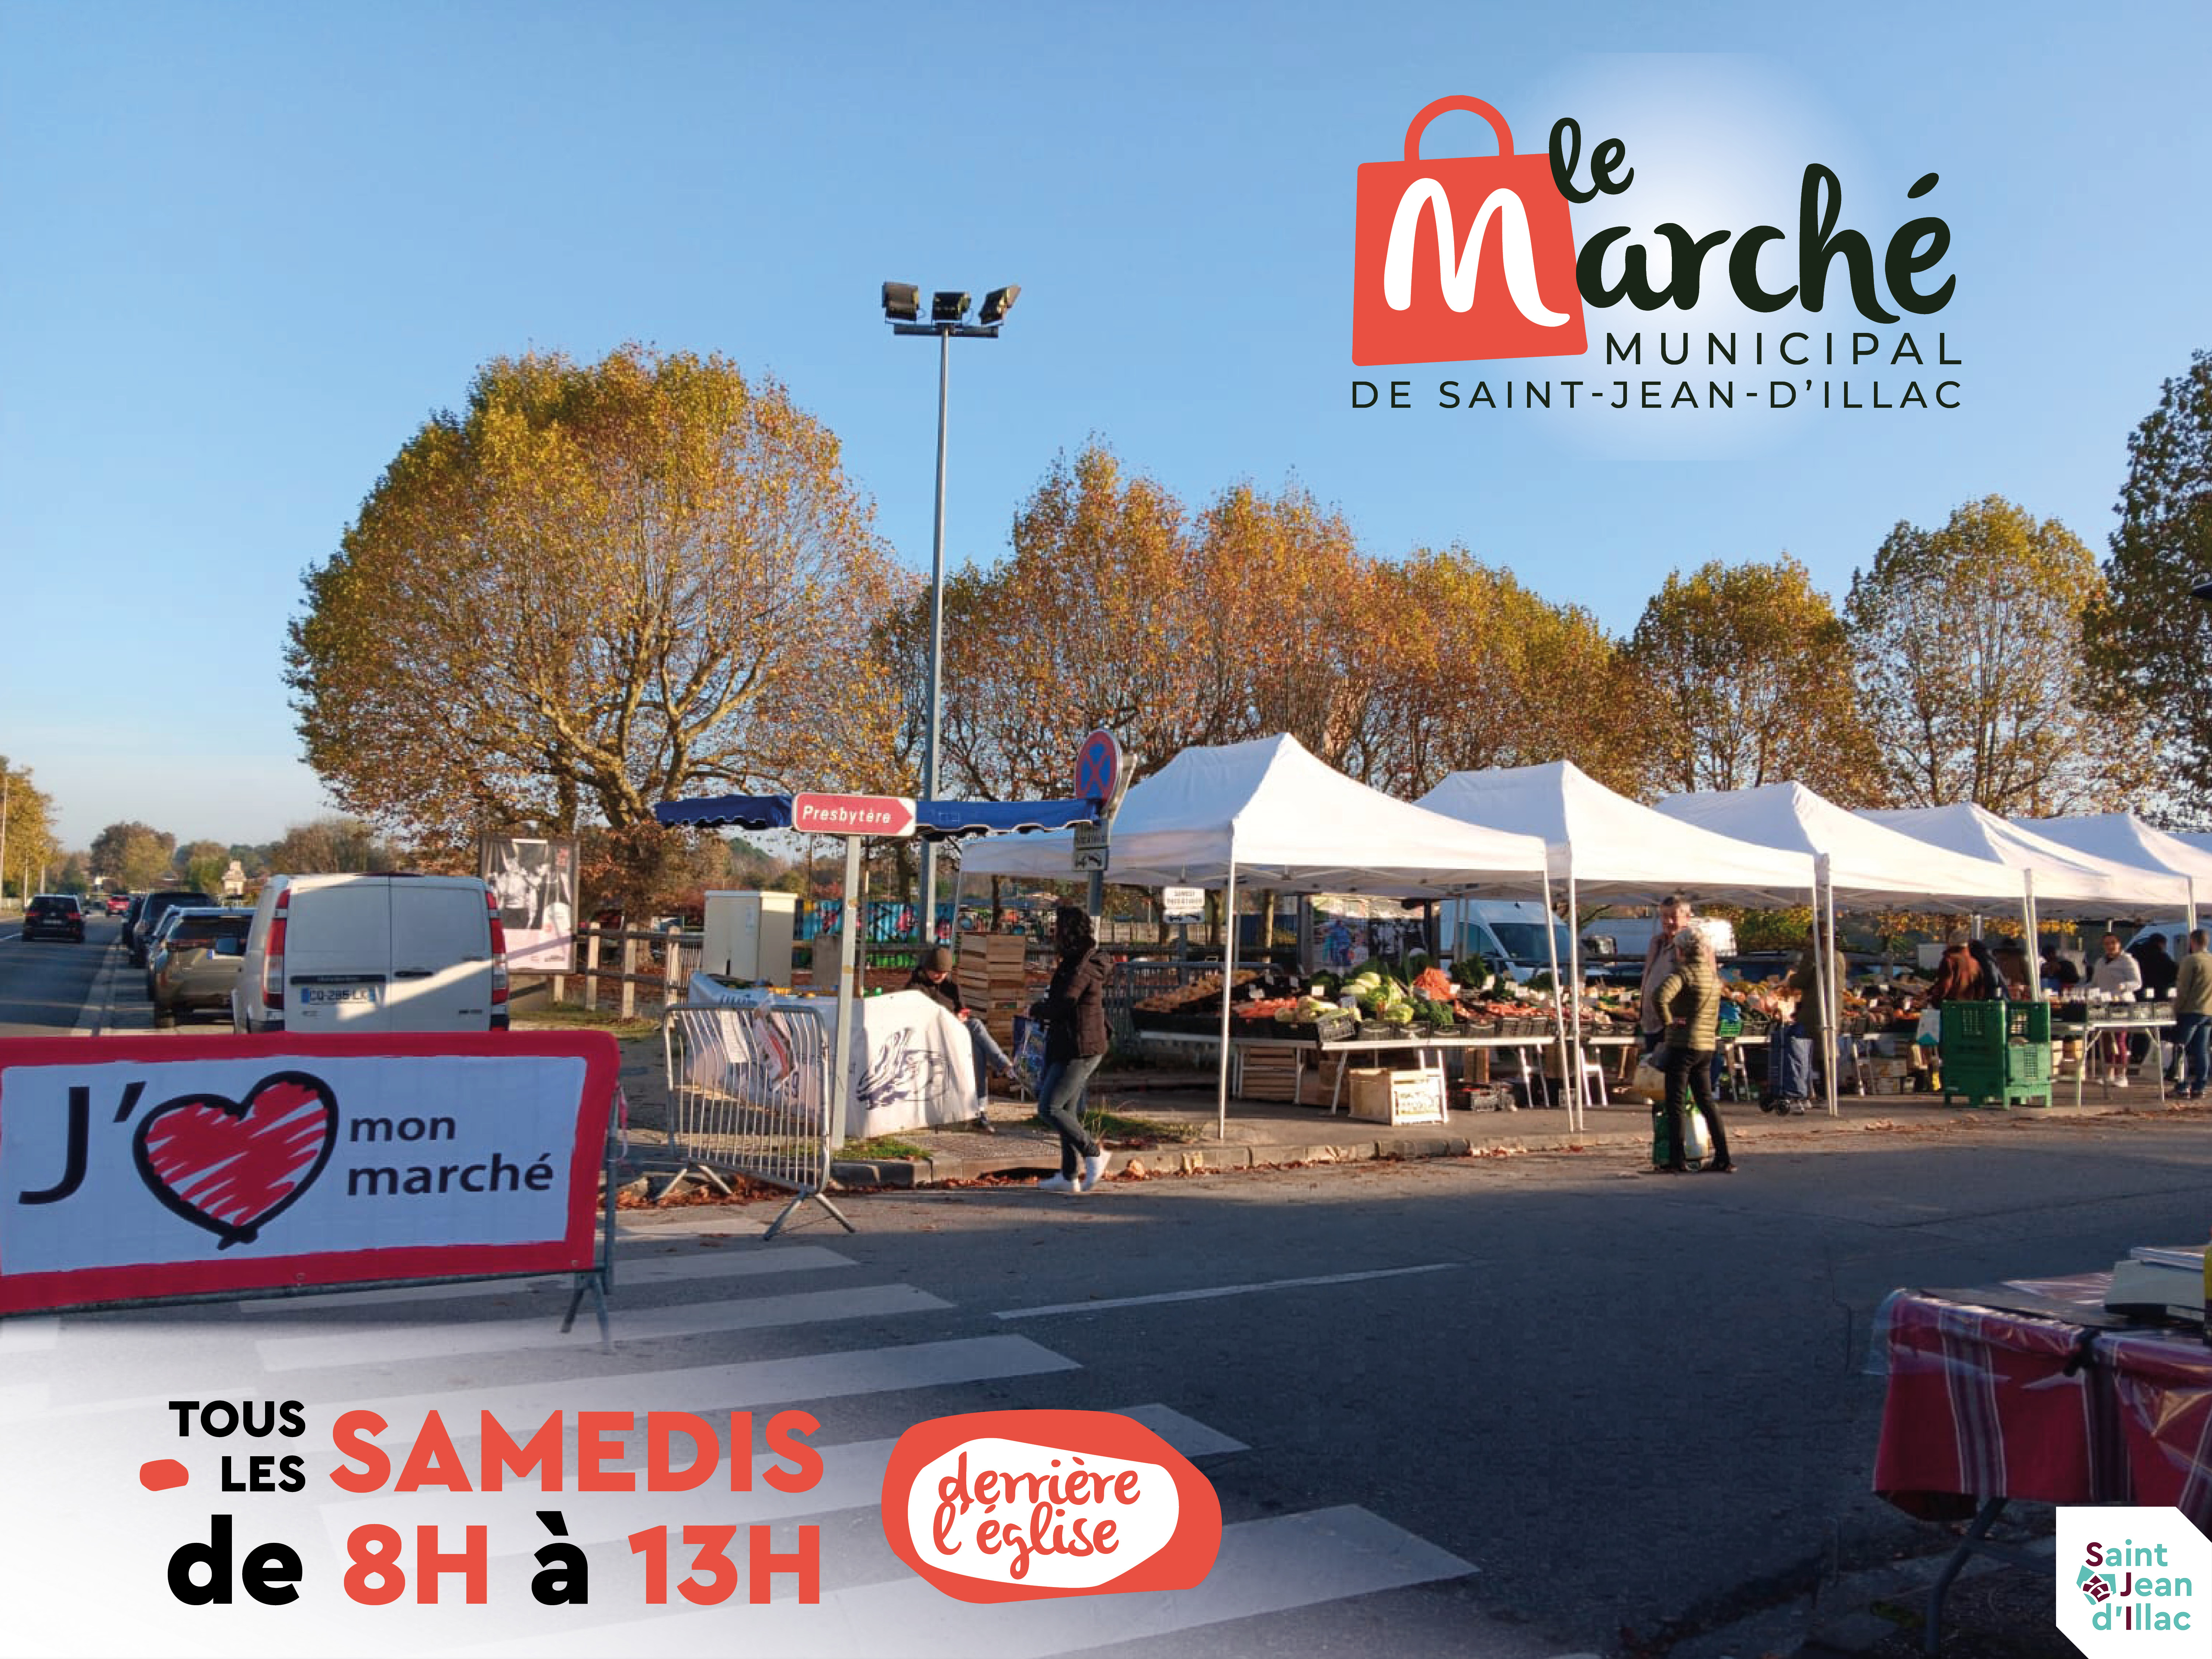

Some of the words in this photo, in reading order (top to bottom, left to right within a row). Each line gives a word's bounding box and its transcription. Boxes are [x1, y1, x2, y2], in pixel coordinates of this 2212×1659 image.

[803, 804, 891, 825] Presbytère
[18, 1081, 147, 1205] J'
[349, 1116, 456, 1142] mon
[347, 1152, 554, 1197] marché
